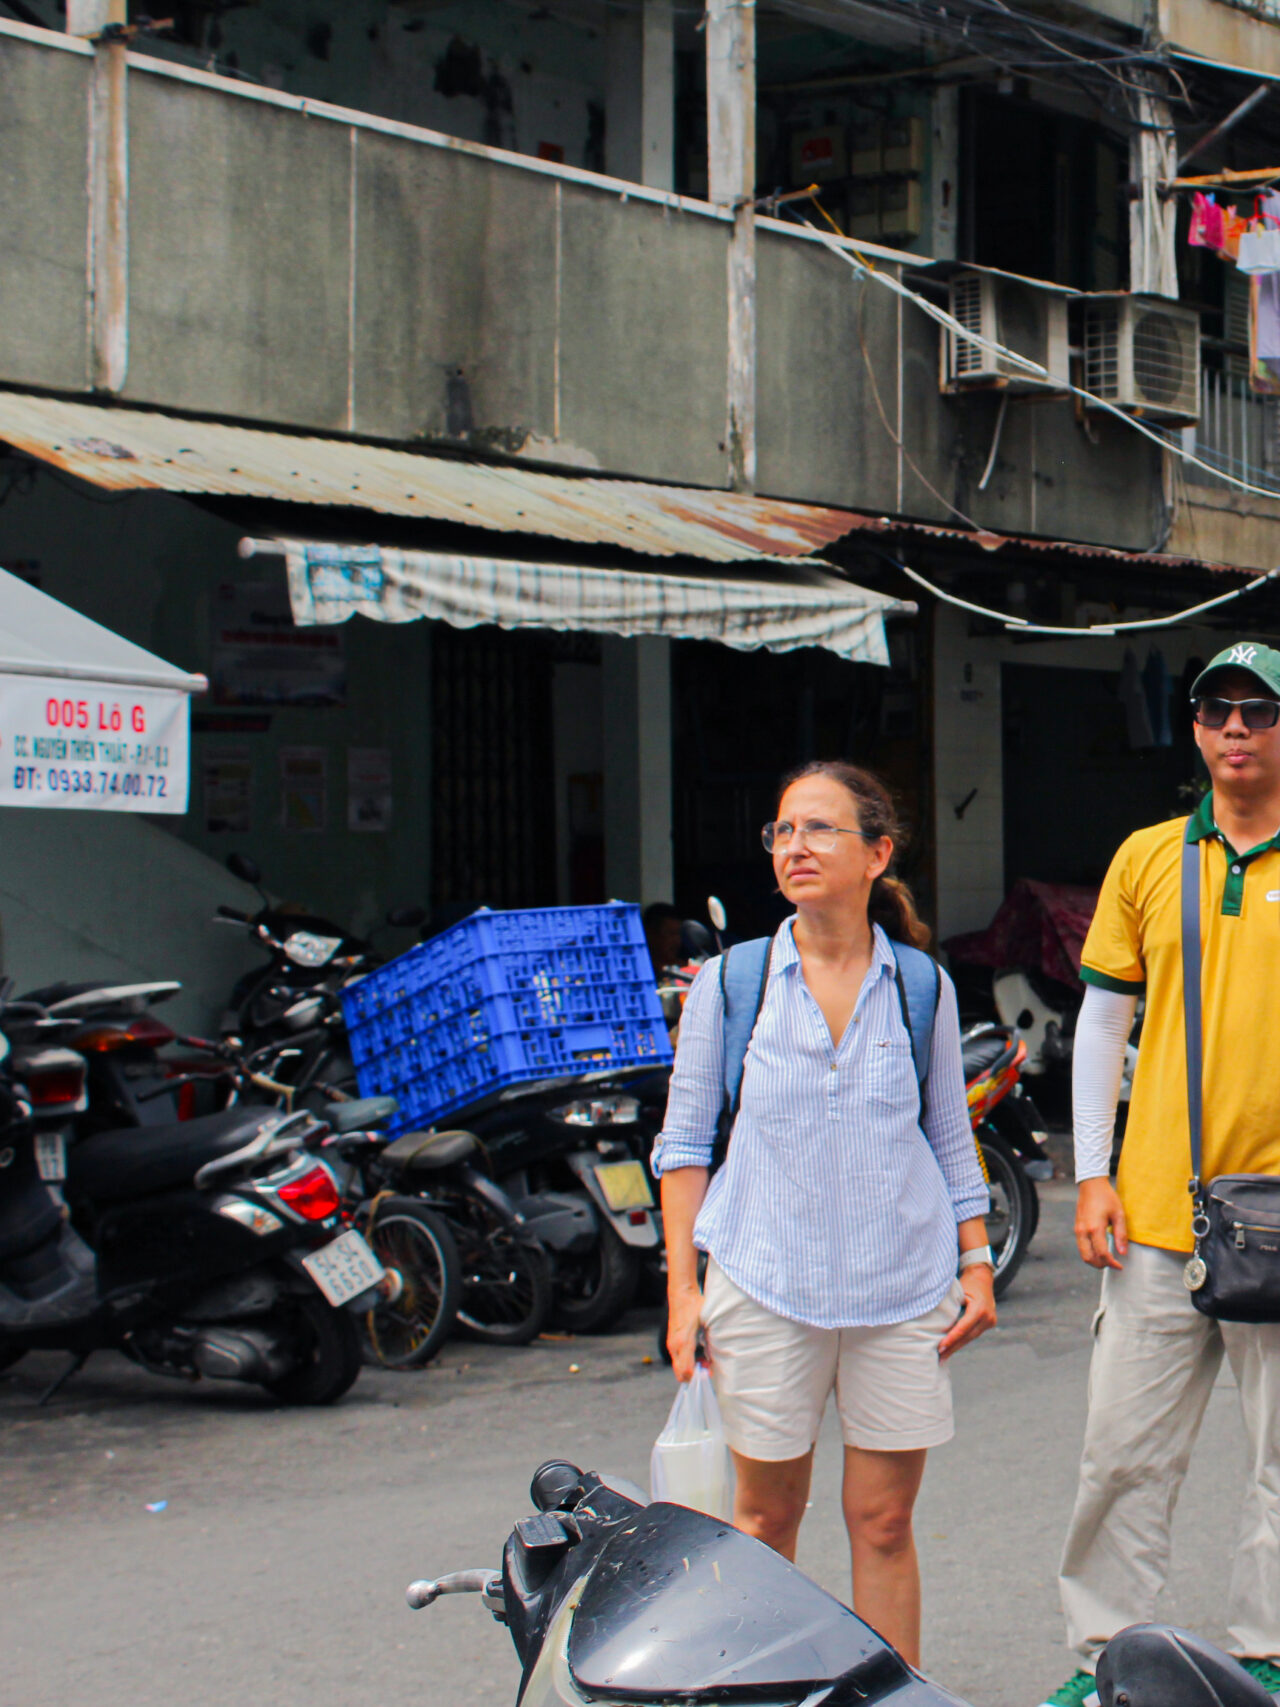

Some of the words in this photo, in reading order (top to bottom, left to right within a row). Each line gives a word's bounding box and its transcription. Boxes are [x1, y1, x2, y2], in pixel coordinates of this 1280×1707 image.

[46, 698, 89, 729] 005
[98, 702, 122, 732] Lô
[132, 705, 145, 733] G
[13, 766, 42, 791] ĐT:
